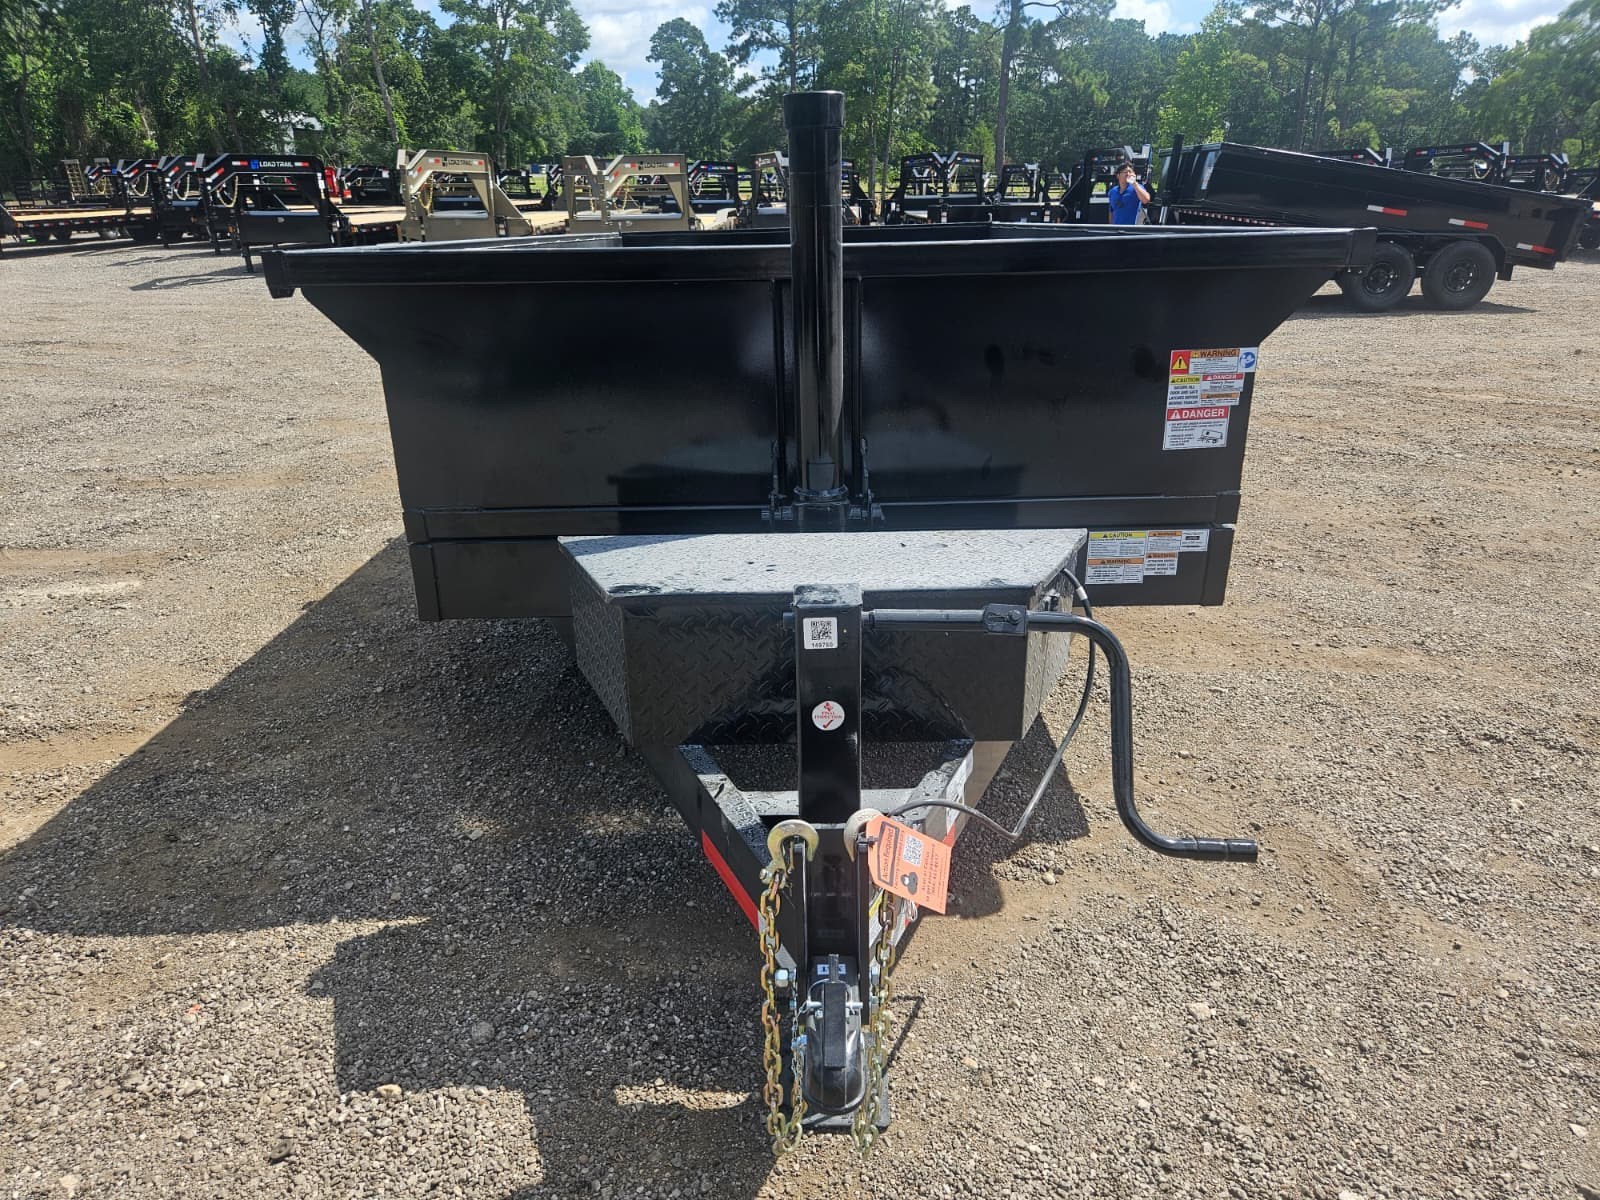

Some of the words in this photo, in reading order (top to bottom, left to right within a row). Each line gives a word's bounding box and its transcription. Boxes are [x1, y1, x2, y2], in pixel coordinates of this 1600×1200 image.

[1200, 349, 1237, 358] WARNING
[1182, 408, 1225, 419] DANGER
[885, 829, 894, 858] Required
